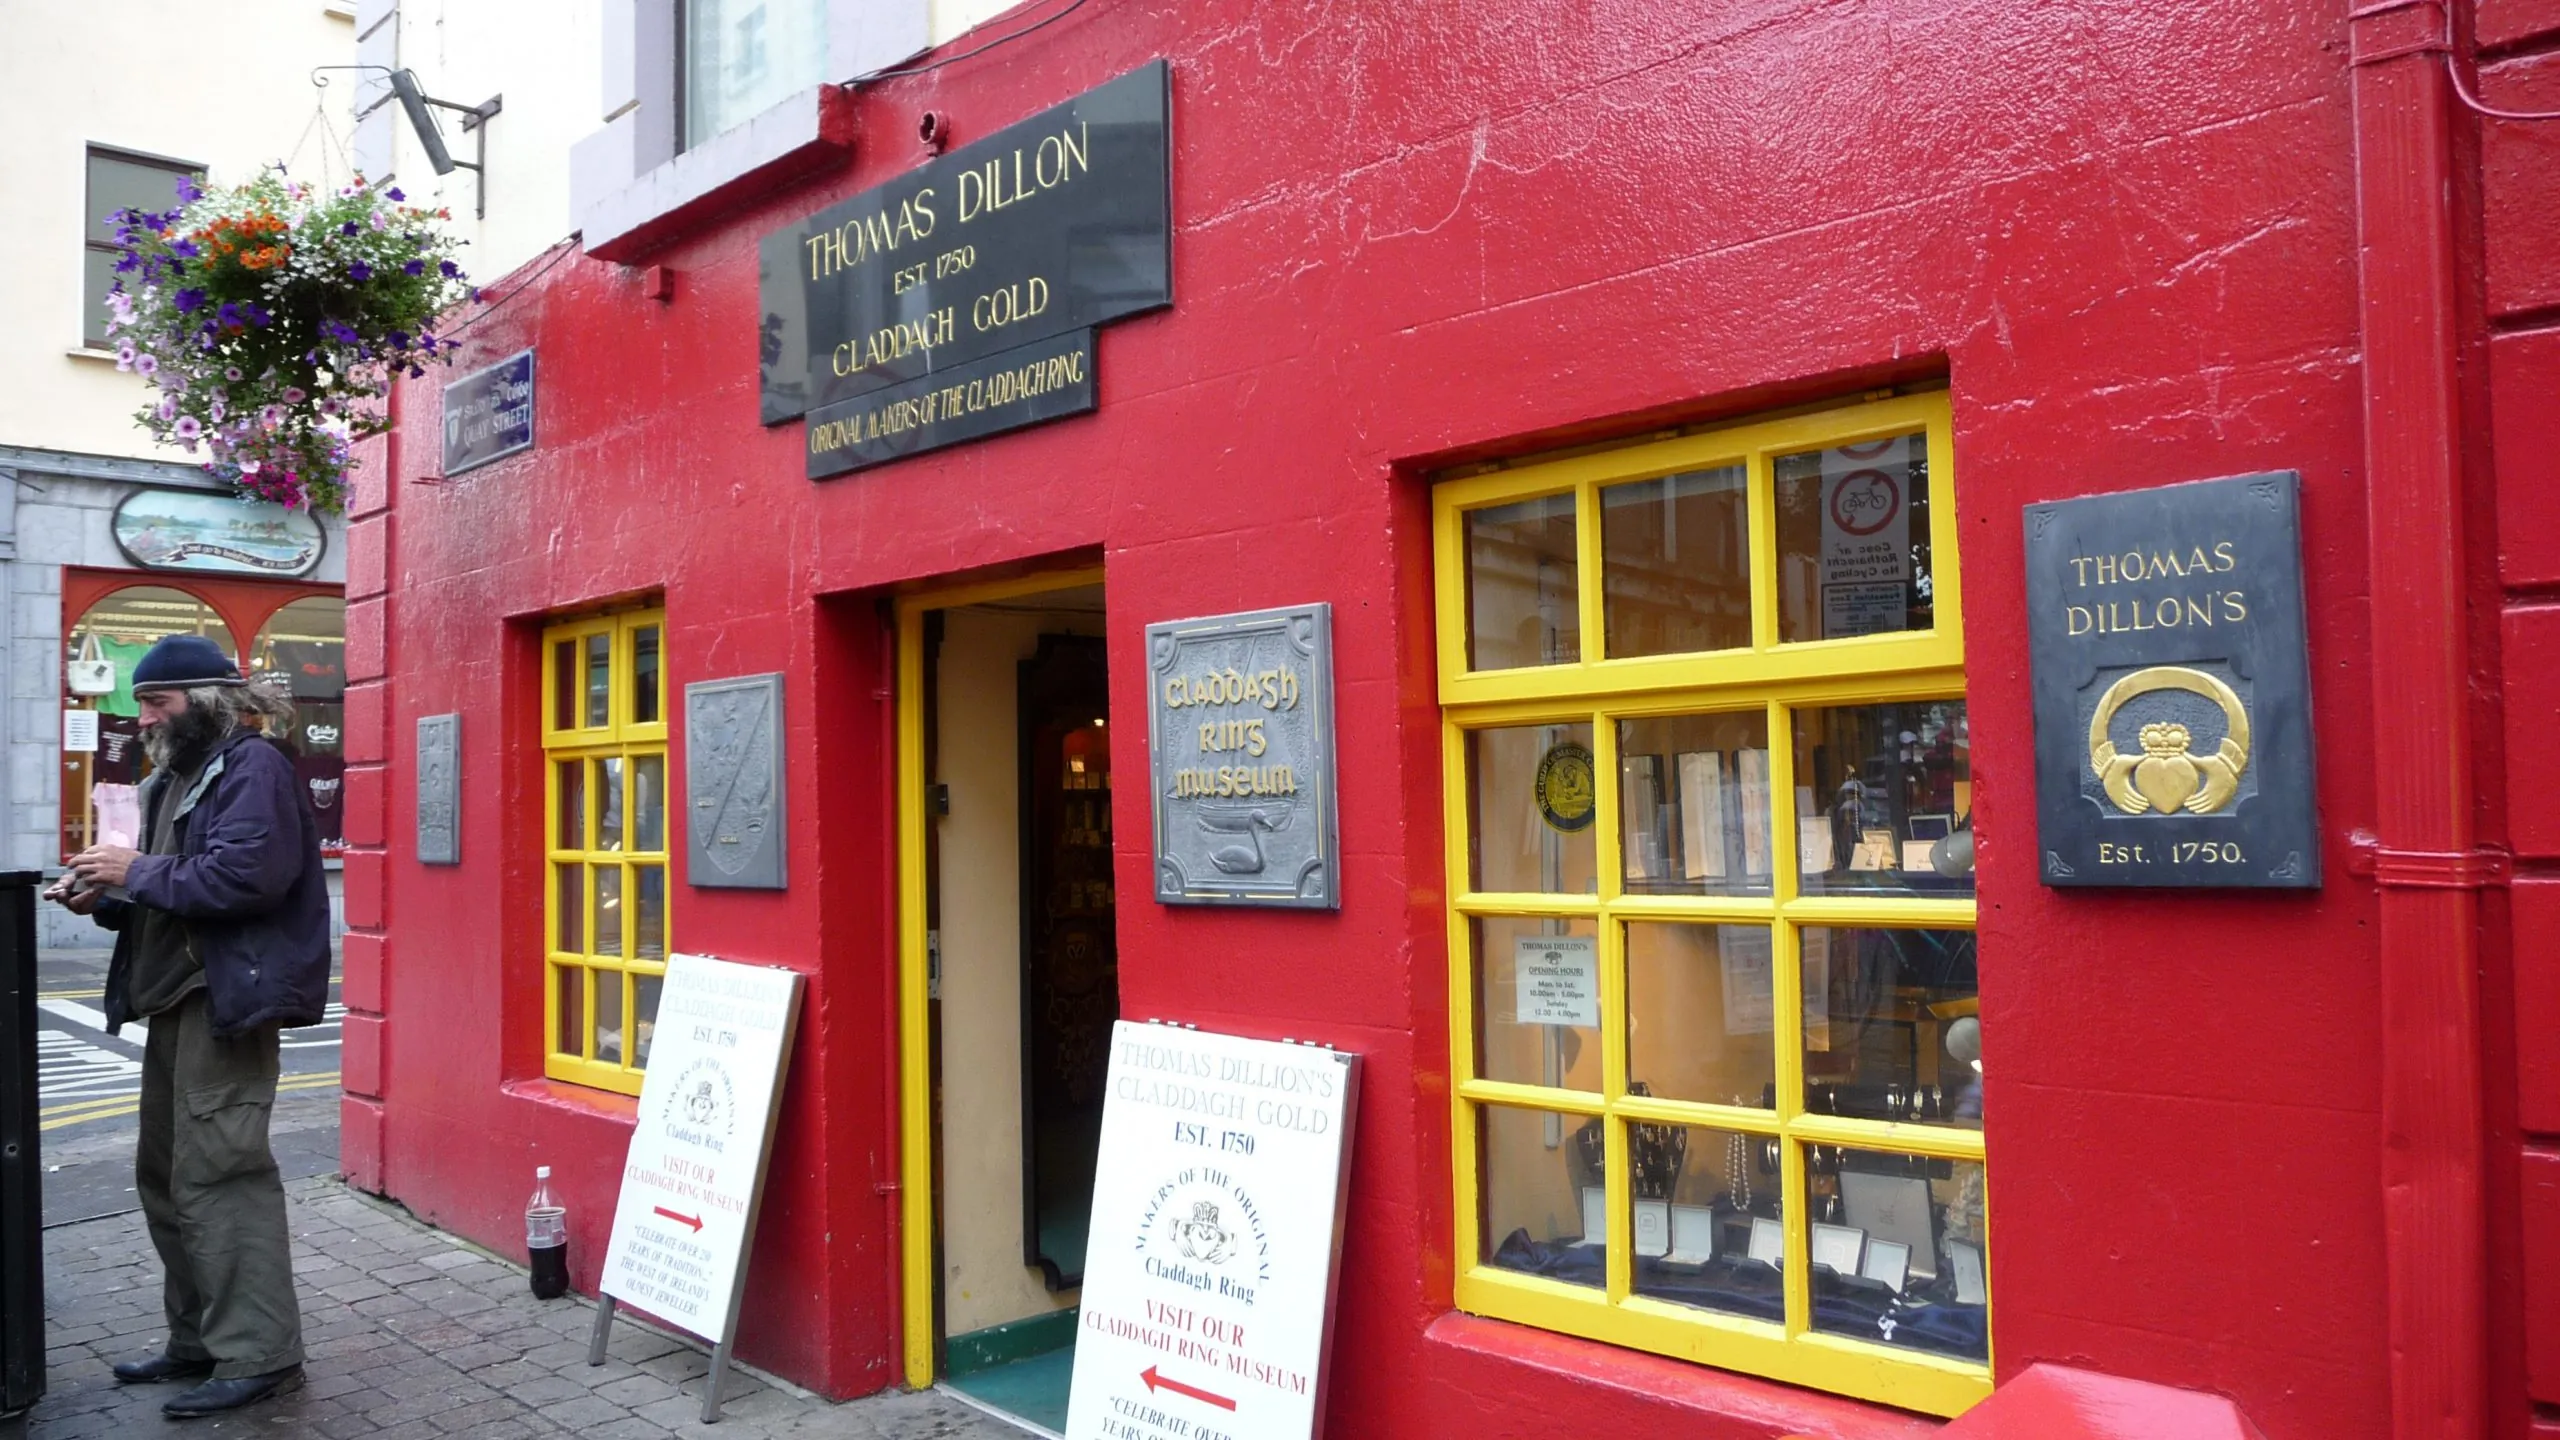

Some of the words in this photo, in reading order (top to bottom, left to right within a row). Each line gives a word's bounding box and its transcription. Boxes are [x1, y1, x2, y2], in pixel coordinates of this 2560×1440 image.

[806, 188, 936, 281] THOMAS
[958, 121, 1089, 223] DILLON
[936, 244, 976, 280] 1750
[832, 306, 954, 378] CLADDAGH
[973, 276, 1049, 333] GOLD
[492, 404, 529, 434] STREET
[811, 404, 862, 454] ORIGINAL
[864, 398, 919, 441] MAKERS
[920, 393, 939, 424] OF
[940, 384, 964, 421] THE
[967, 360, 1045, 413] CLADDAGH
[1046, 350, 1085, 389] RING
[2069, 541, 2237, 588] THOMAS
[2065, 590, 2249, 637] DILLON'S
[2099, 842, 2151, 866] Est.
[2172, 841, 2248, 865] 1750.
[1521, 942, 1552, 951] THOMAS
[1554, 942, 1588, 952] DILLON'S
[1529, 966, 1559, 976] OPENING
[1560, 967, 1584, 976] HOURS
[1119, 1041, 1212, 1079] THOMAS
[1117, 1075, 1245, 1121] CLADDAGH
[1257, 1100, 1329, 1135] GOLD
[666, 1123, 701, 1146] Claddagh
[705, 1133, 724, 1154] Ring
[1174, 1120, 1212, 1148] EST.
[1222, 1130, 1255, 1156] 1750
[627, 1164, 676, 1193] CLADDAGH
[677, 1180, 699, 1201] RING
[703, 1188, 744, 1215] MUSEUM
[663, 1154, 690, 1178] VISIT
[692, 1164, 715, 1185] OUR
[1135, 1179, 1175, 1251] MAKERS
[1178, 1167, 1196, 1186] OF
[1202, 1166, 1232, 1190] THE
[1233, 1186, 1271, 1287] ORIGINAL
[1145, 1256, 1212, 1291] Claddagh
[1219, 1275, 1255, 1306] Ring
[1145, 1298, 1197, 1333] VISIT
[1202, 1315, 1245, 1348] OUR
[1086, 1310, 1171, 1353] CLADDAGH
[1177, 1337, 1218, 1367] RING
[1226, 1352, 1308, 1395] MUSEUM
